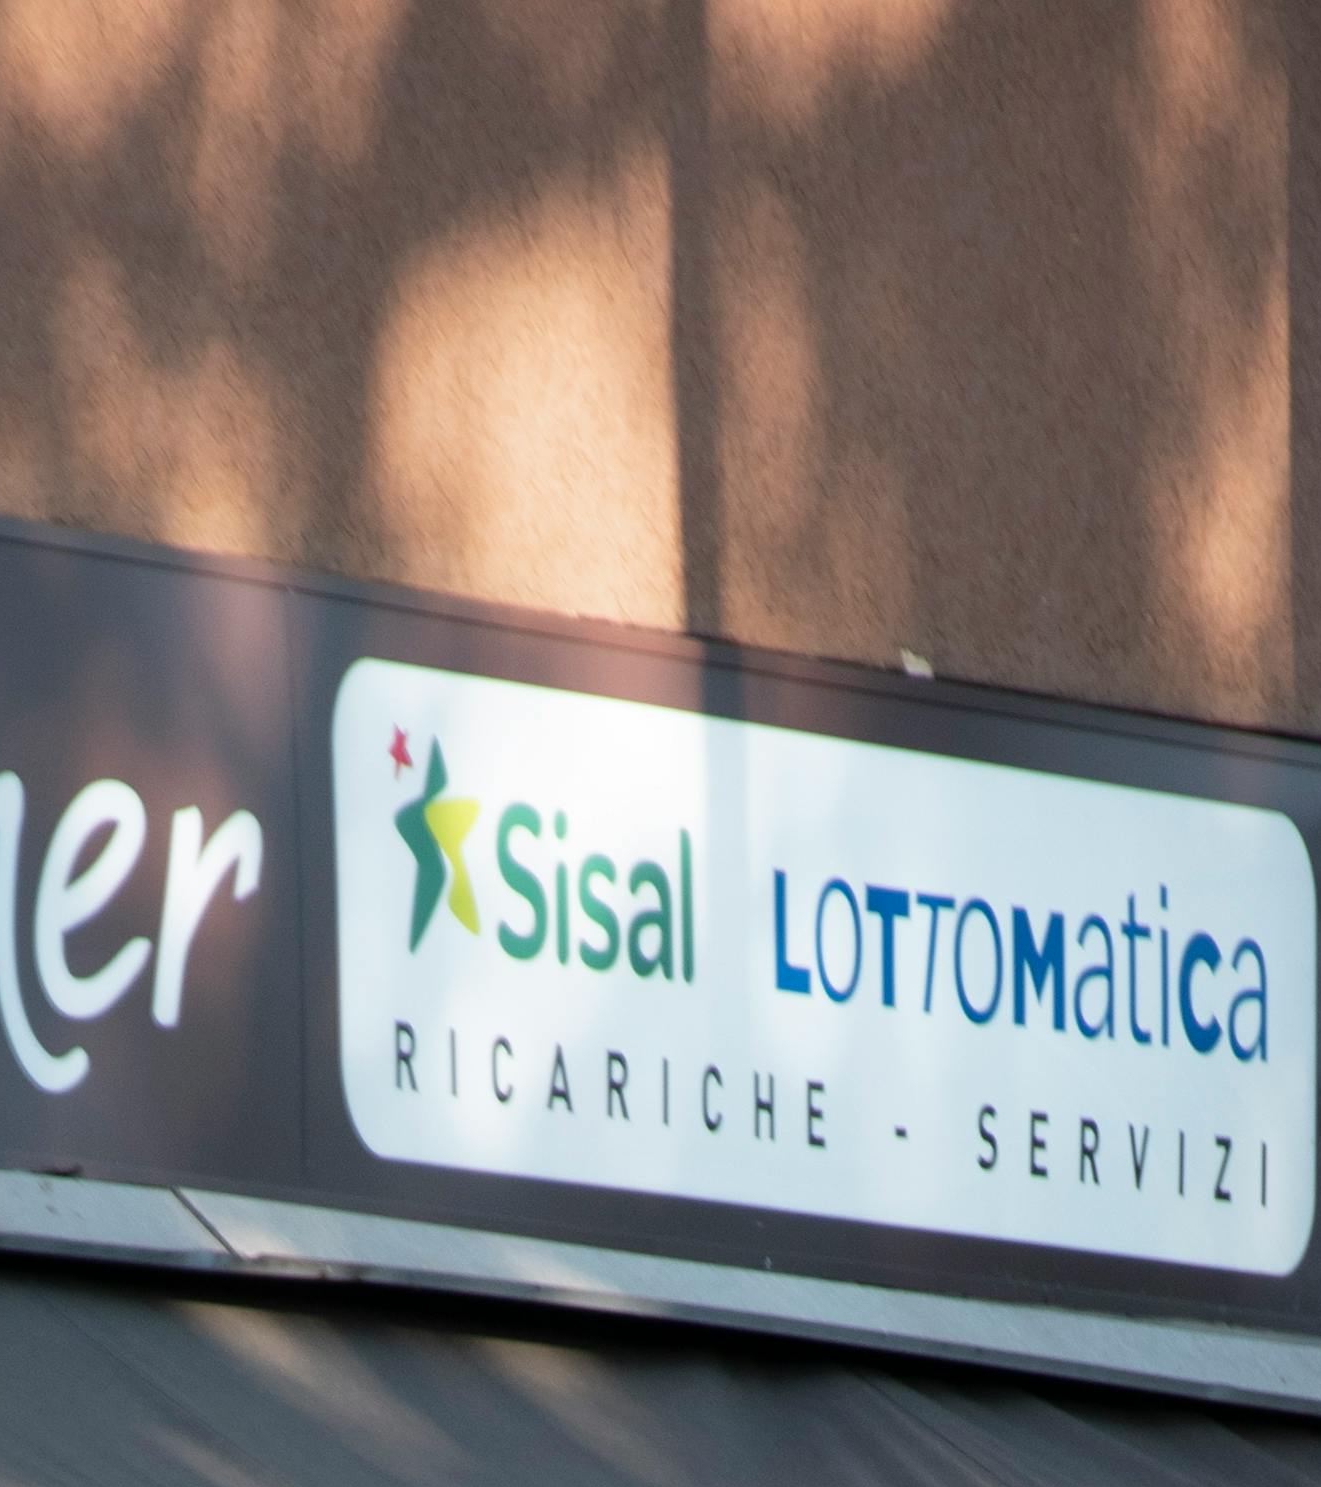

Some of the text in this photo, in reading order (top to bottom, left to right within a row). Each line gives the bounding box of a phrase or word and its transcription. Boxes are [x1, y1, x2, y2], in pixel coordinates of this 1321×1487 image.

[495, 800, 693, 984] Sisal
[394, 1020, 826, 1150] RICARICHE
[978, 1105, 1269, 1206] SERVIZI
